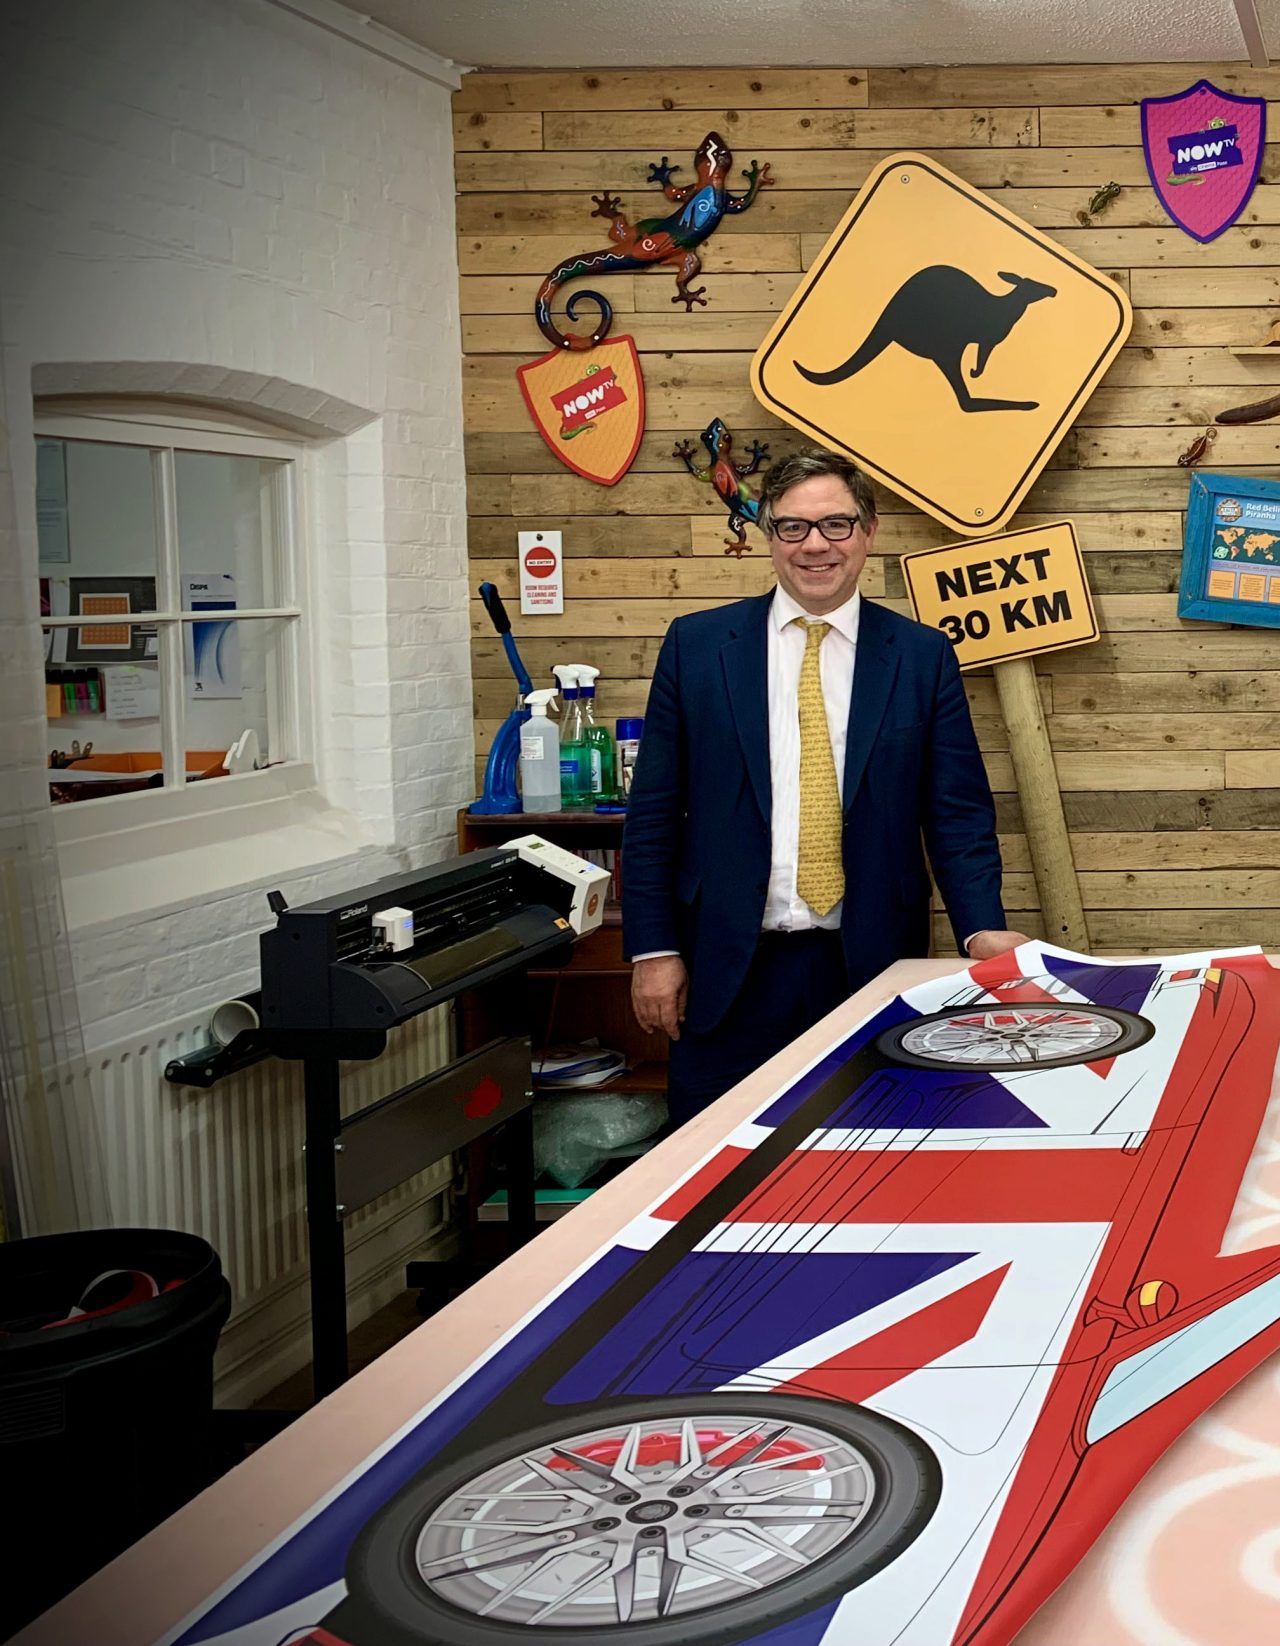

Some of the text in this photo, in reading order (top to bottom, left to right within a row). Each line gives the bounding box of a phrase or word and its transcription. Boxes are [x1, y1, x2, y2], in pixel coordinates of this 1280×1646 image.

[1178, 141, 1223, 164] NOW
[563, 385, 604, 418] NOW
[935, 548, 1050, 602] NEXT
[938, 590, 1072, 646] 30 KM
